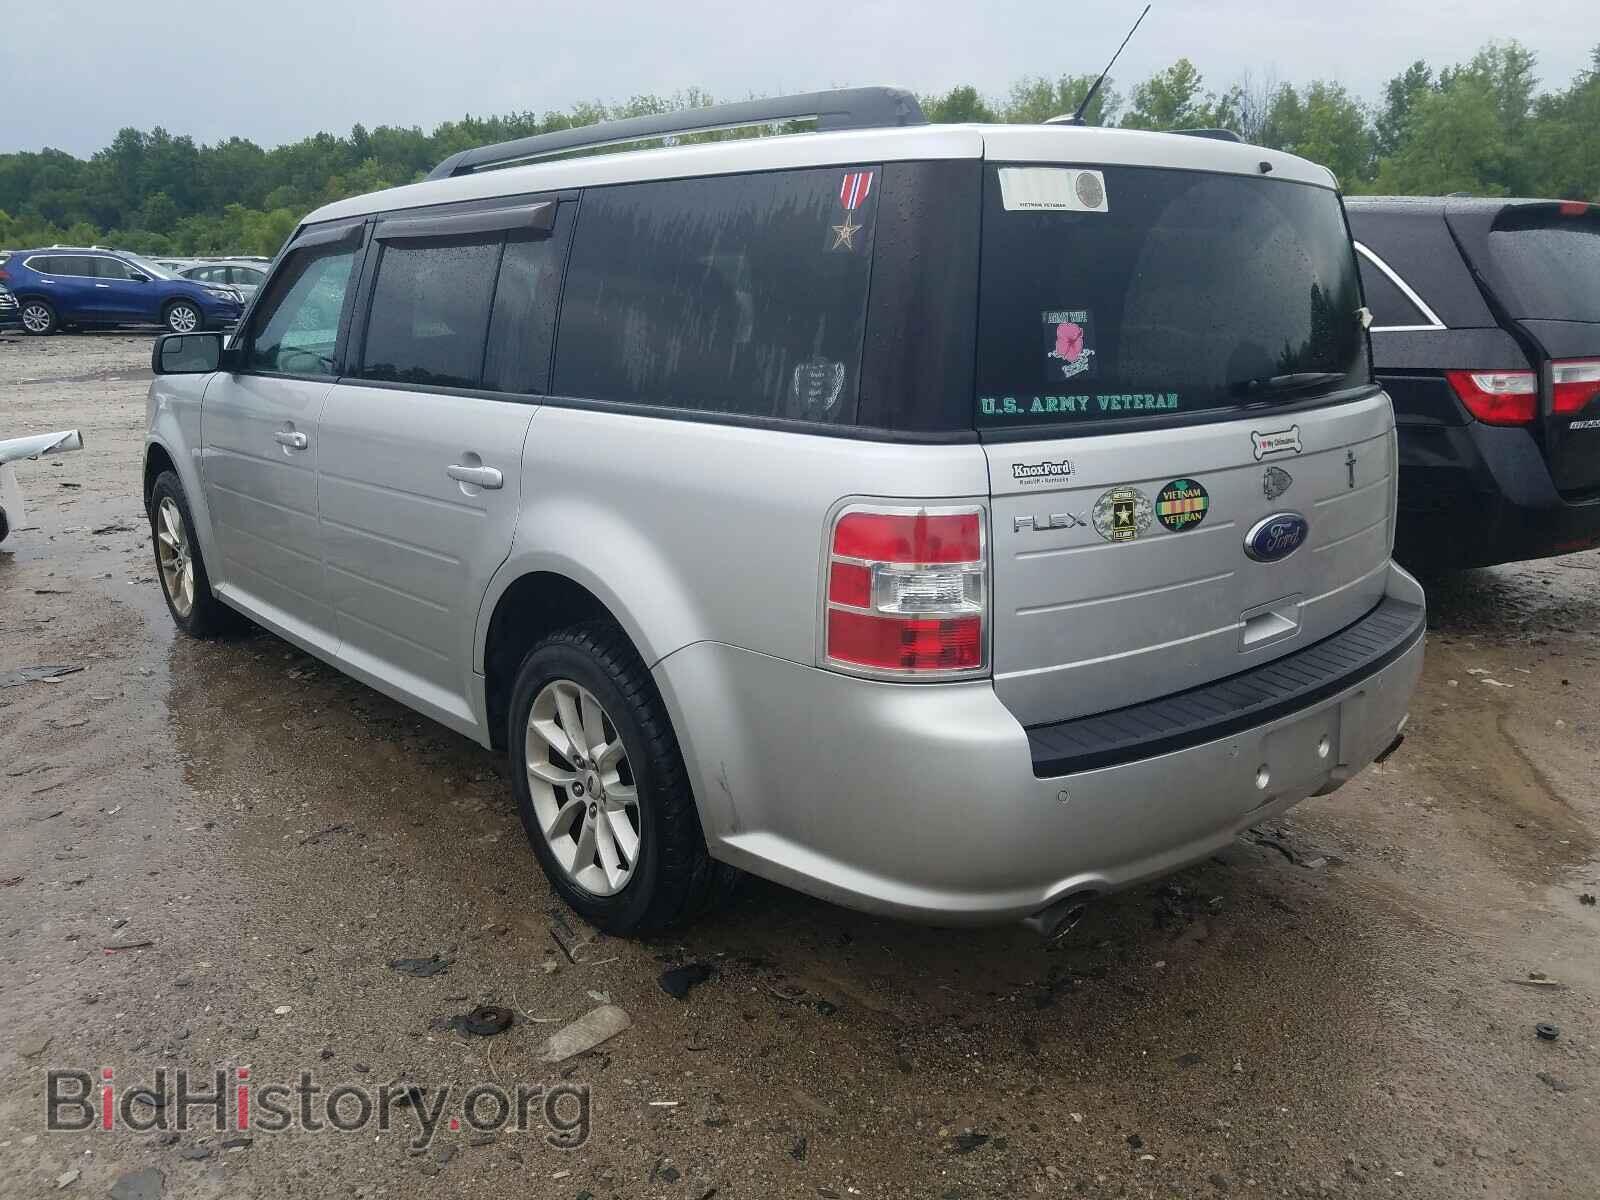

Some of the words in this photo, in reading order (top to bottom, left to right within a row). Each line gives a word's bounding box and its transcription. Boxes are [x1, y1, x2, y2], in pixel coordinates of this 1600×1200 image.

[981, 397, 1025, 414] U.S.
[1030, 396, 1089, 412] ARMY
[1097, 393, 1178, 410] VETERAN
[1012, 459, 1071, 478] KnoxFord
[1163, 488, 1201, 501] VIETNAM
[1013, 511, 1088, 533] FLEX
[1164, 512, 1202, 525] VETERAN
[1265, 522, 1301, 552] Ford
